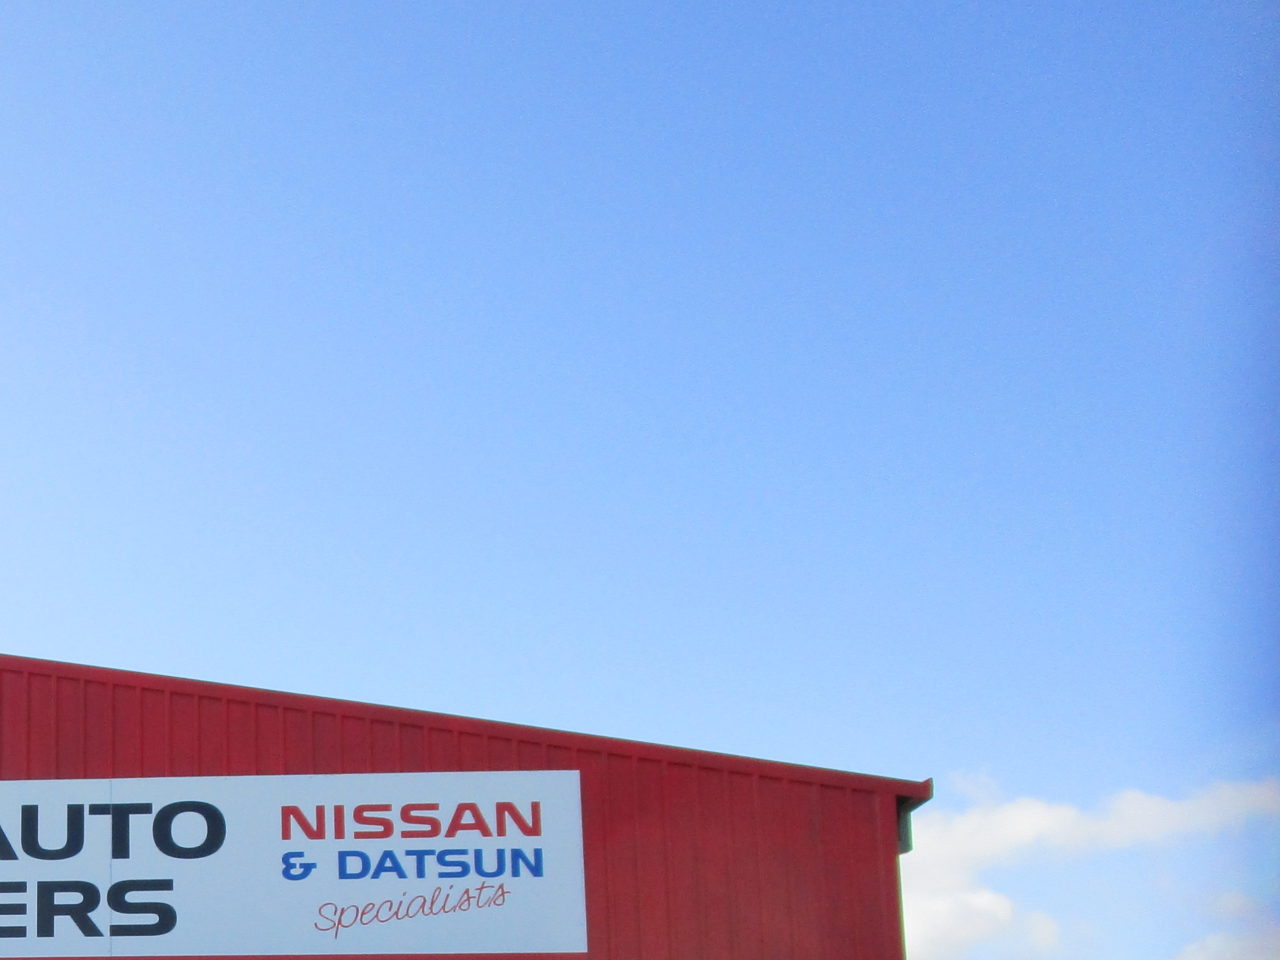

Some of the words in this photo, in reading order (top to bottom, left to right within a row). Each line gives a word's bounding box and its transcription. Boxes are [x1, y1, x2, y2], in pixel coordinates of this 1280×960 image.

[280, 801, 543, 841] NISSAN
[281, 850, 318, 881] &
[337, 848, 545, 880] DATSUN
[314, 882, 511, 939] Specialists
